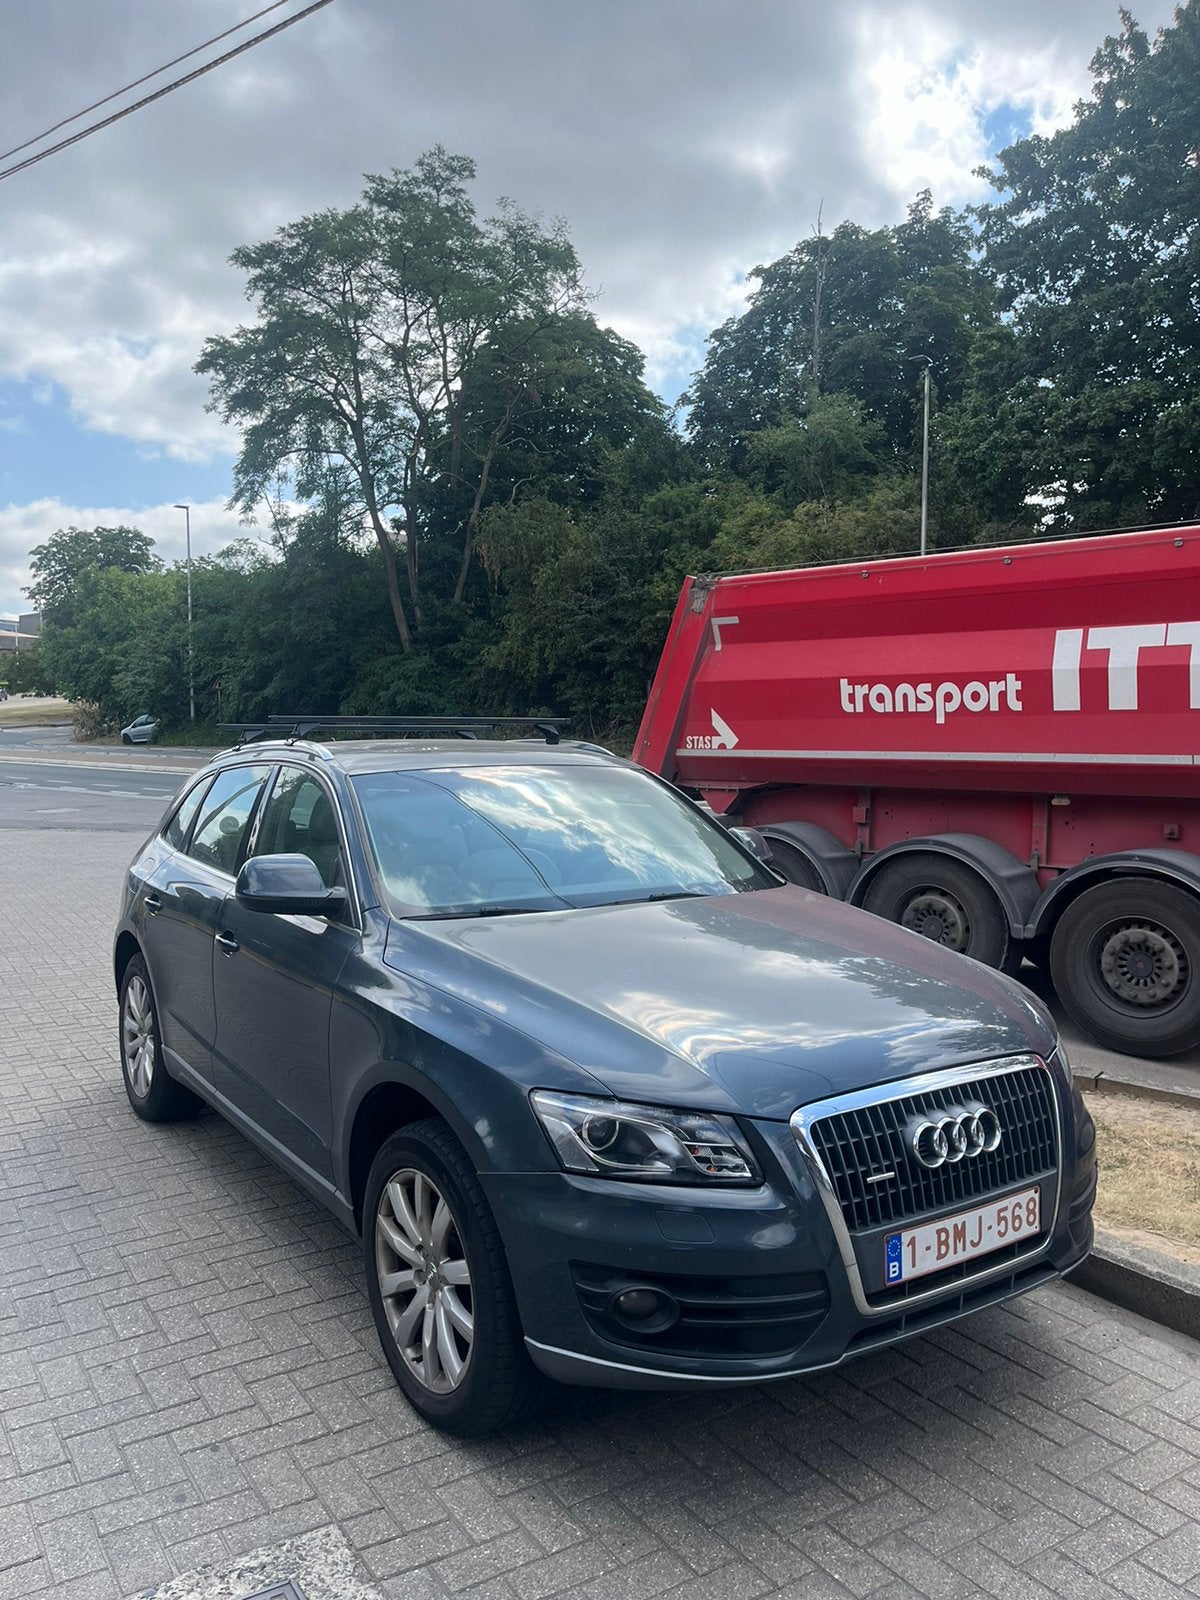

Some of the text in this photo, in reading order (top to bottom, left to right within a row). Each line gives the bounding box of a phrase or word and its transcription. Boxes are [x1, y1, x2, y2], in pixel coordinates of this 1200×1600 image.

[839, 673, 1023, 724] transport
[686, 735, 711, 749] STAS
[906, 1196, 1037, 1269] 1-BMJ-568
[889, 1261, 900, 1278] B
